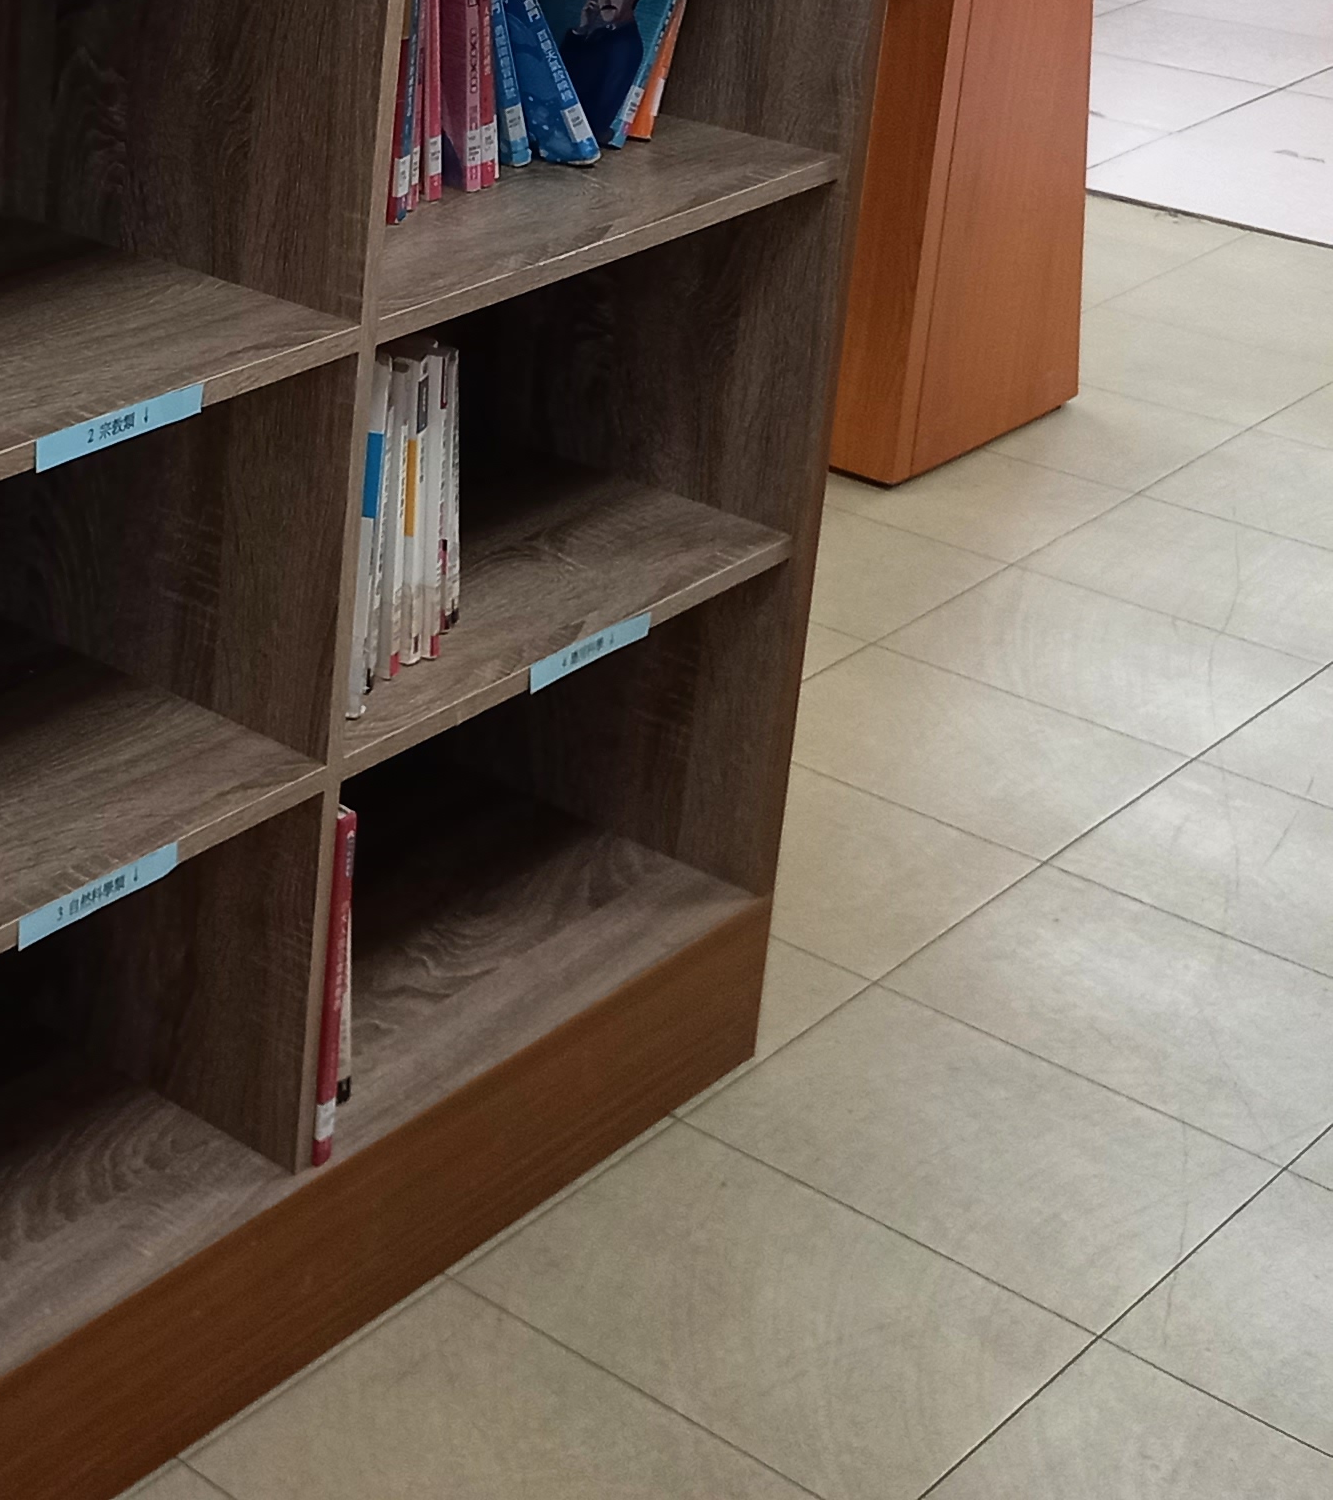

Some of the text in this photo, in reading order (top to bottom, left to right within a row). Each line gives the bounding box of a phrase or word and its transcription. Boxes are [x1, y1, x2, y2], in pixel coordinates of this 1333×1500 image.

[87, 412, 136, 444] 2 宗教類
